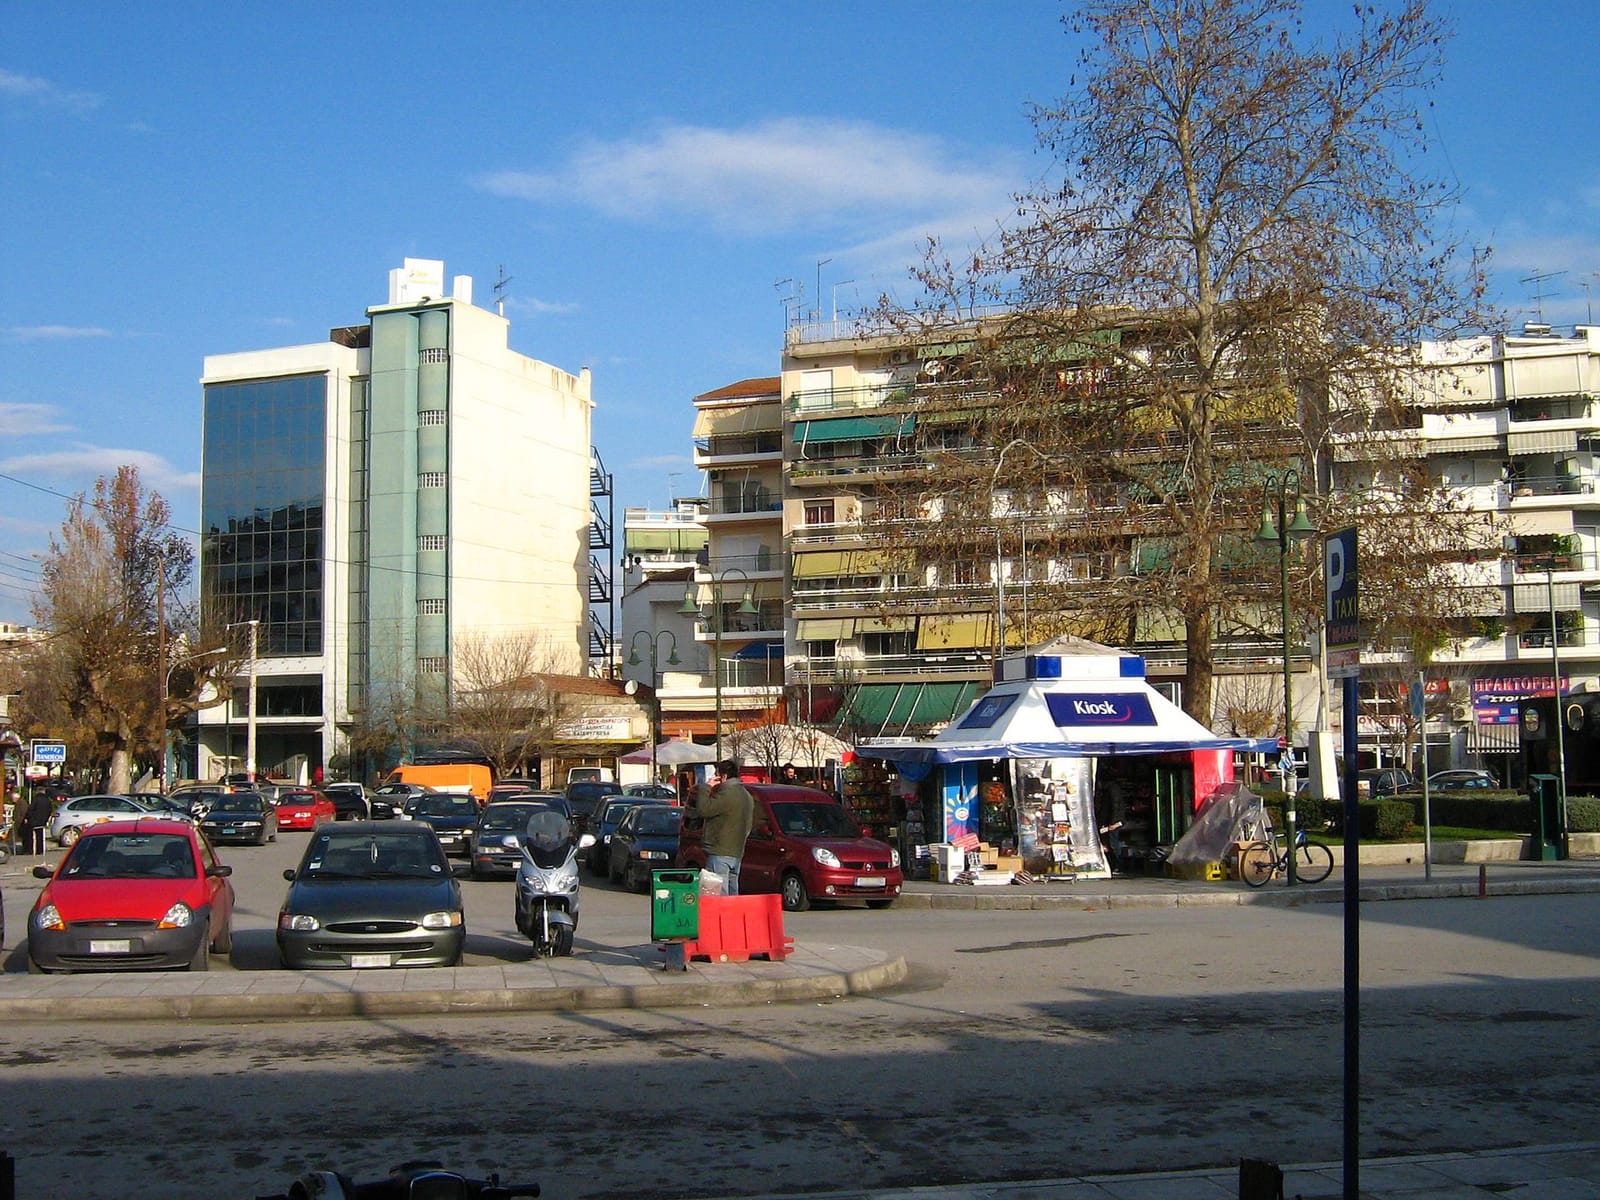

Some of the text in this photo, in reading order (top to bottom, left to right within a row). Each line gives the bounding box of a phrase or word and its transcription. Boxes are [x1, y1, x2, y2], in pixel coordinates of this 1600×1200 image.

[1326, 537, 1345, 621] P
[1335, 596, 1357, 620] TAXI
[1073, 700, 1117, 716] Kiosk
